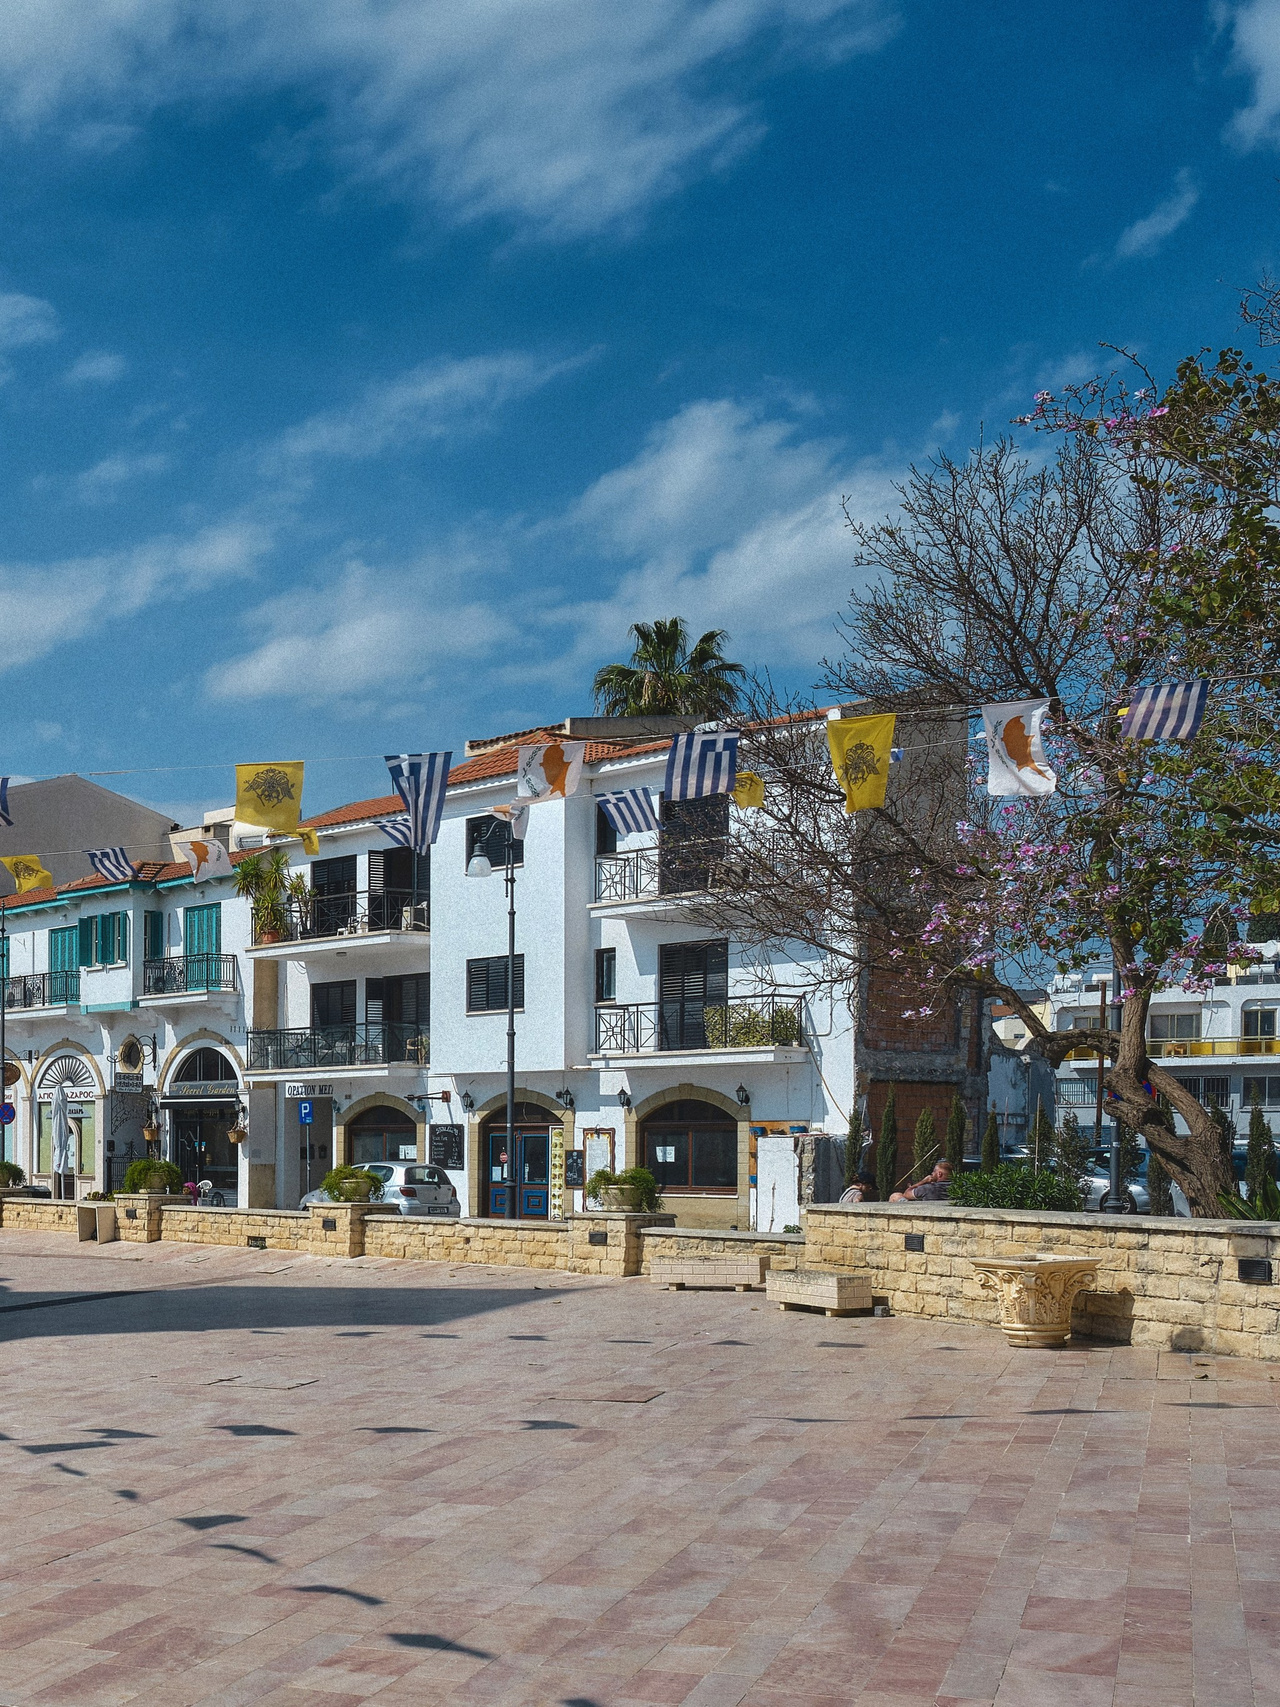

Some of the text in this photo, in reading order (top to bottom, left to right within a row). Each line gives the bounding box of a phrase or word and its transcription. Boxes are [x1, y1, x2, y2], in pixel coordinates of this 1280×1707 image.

[179, 1084, 203, 1095] Secret
[206, 1083, 236, 1094] Garden
[301, 1103, 310, 1118] P
